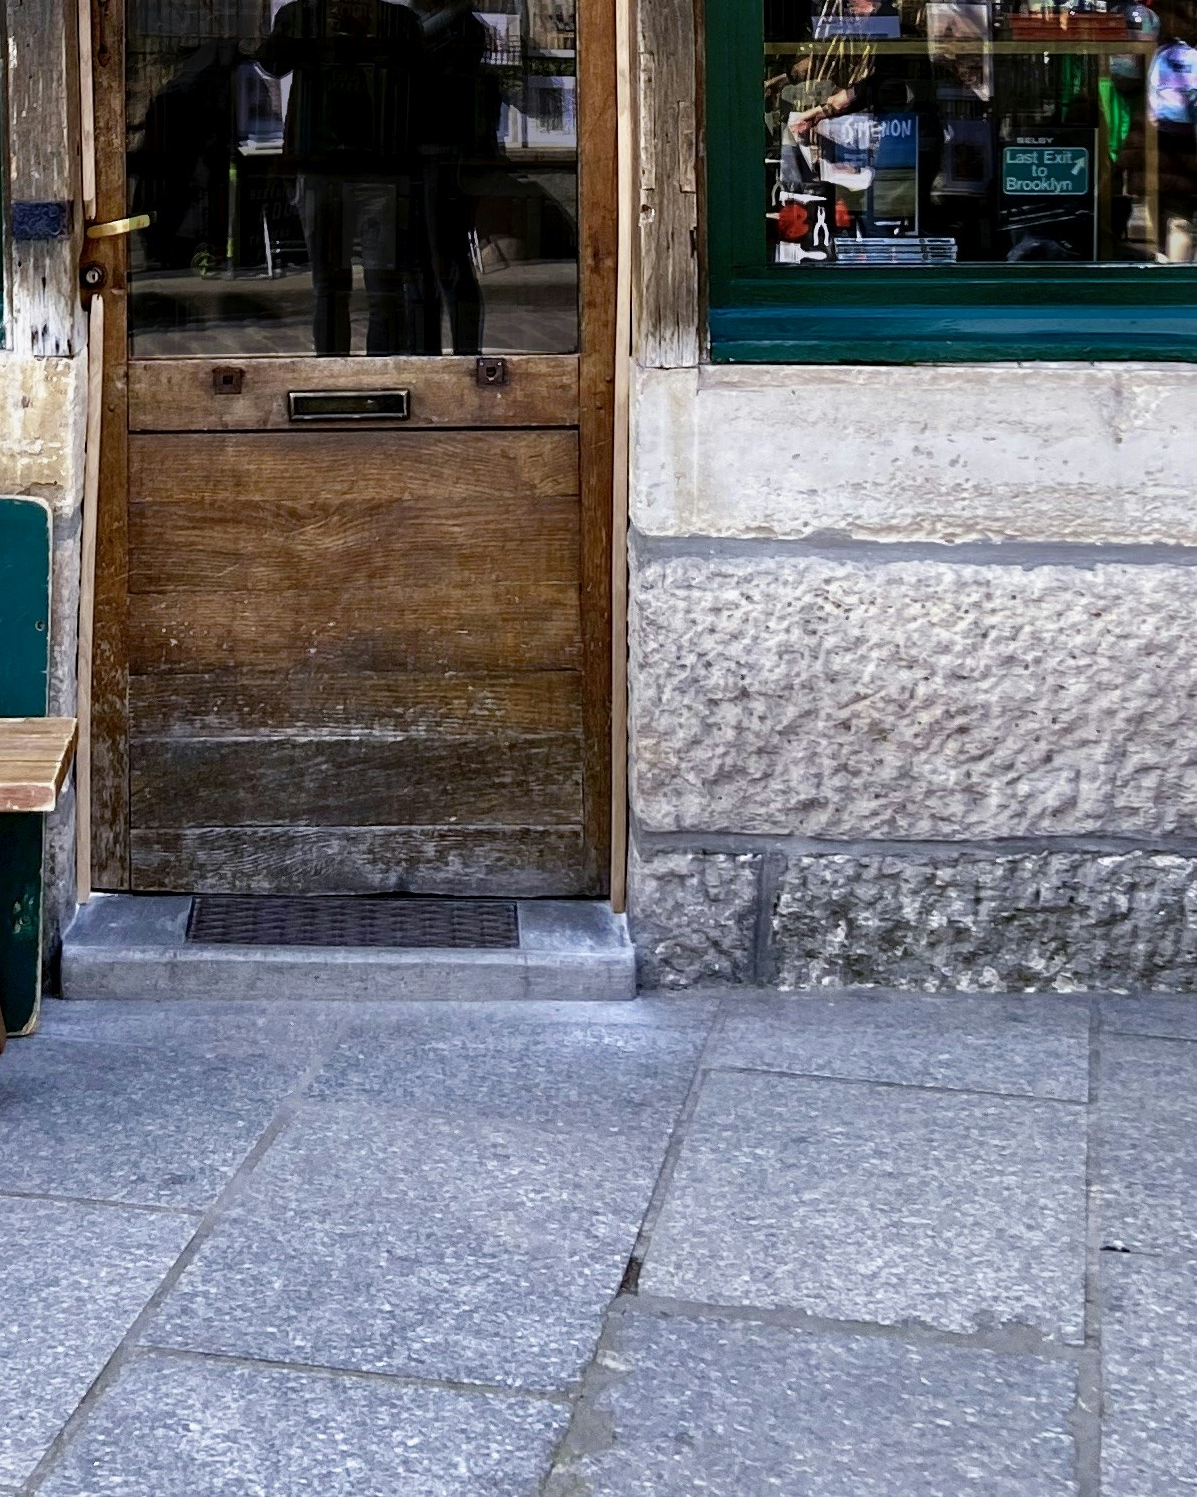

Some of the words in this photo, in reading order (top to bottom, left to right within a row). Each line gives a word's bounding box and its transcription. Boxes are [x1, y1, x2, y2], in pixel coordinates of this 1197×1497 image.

[1007, 150, 1039, 165] Last
[1043, 150, 1073, 165] Exit
[1031, 164, 1049, 178] to
[1006, 176, 1074, 195] Brooklyn
